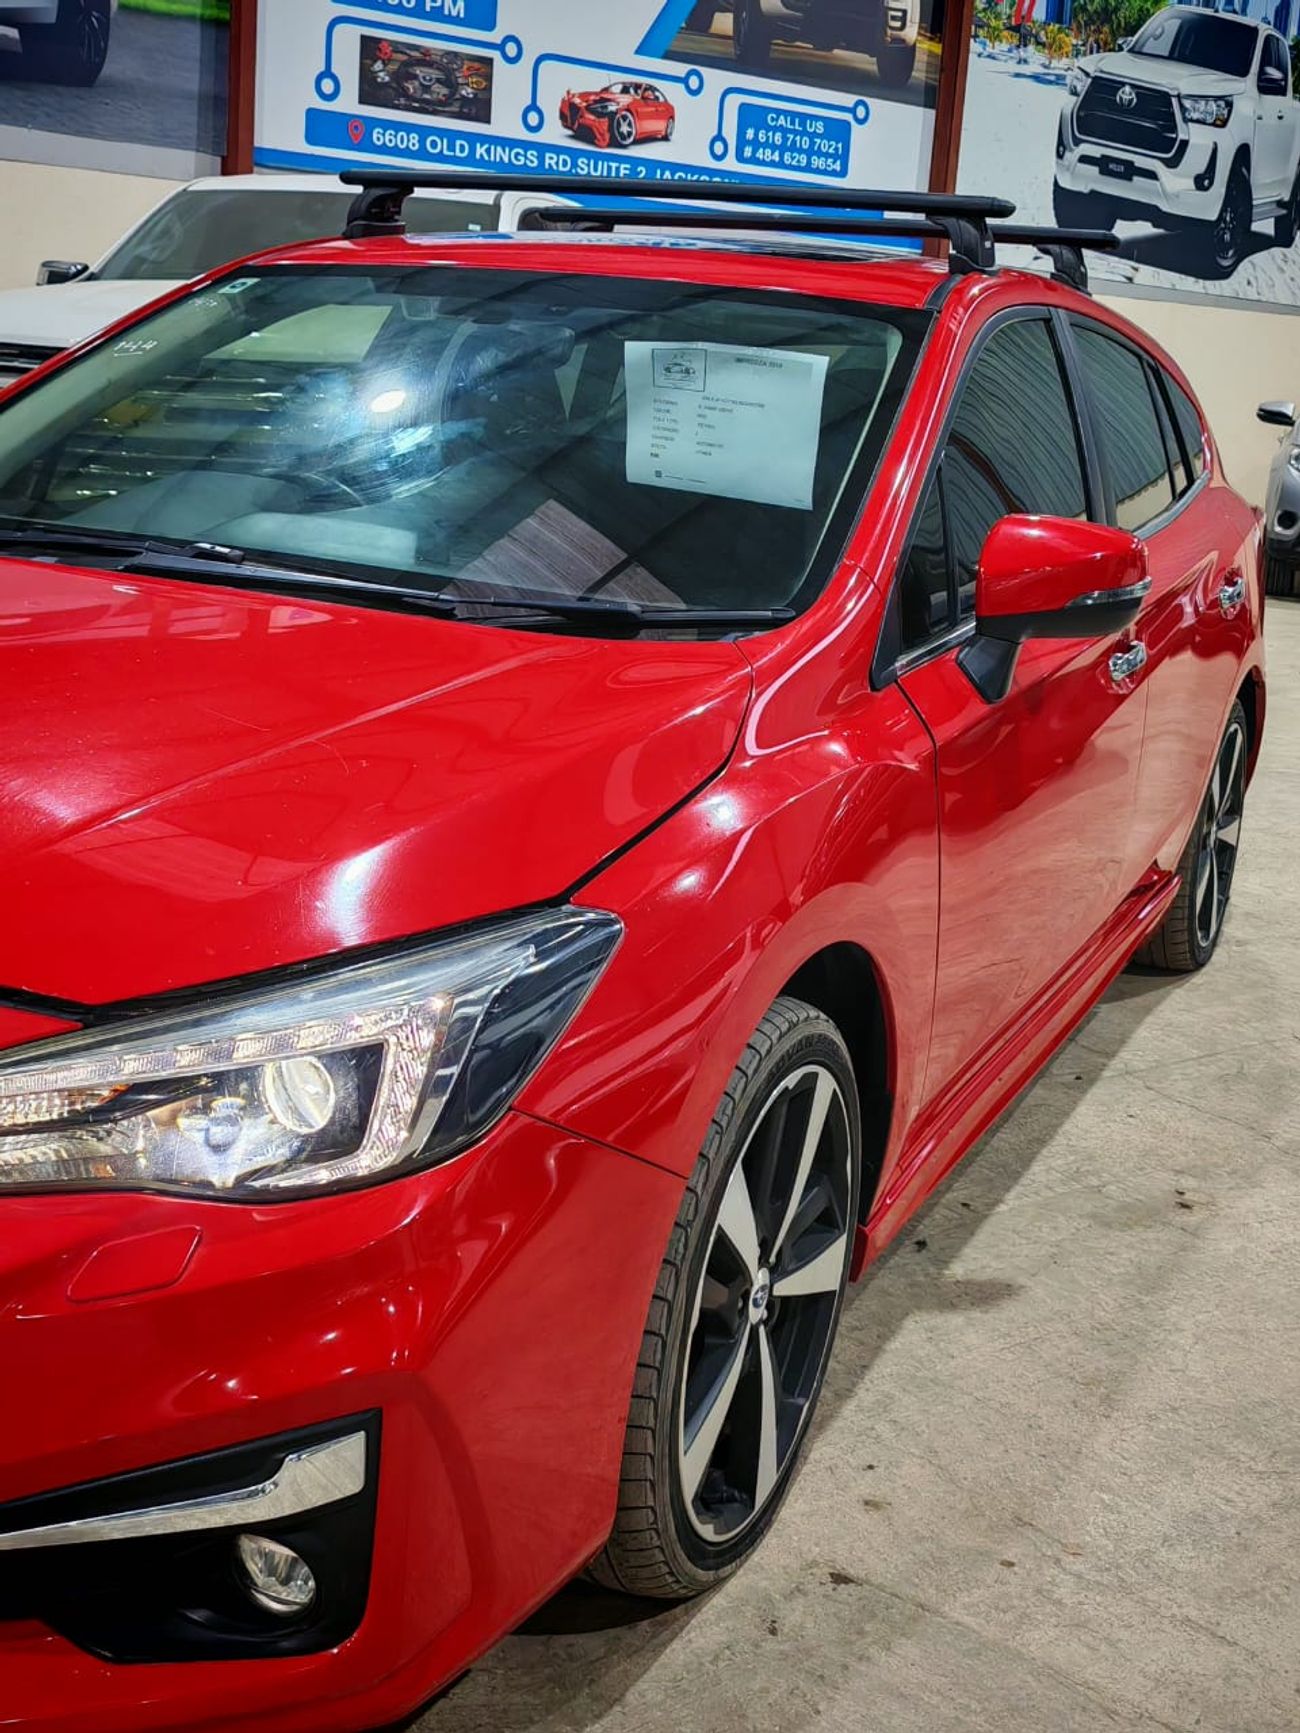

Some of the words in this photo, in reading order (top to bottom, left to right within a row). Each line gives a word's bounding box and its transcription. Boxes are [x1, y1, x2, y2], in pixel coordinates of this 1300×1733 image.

[425, 0, 465, 18] PM
[767, 113, 803, 131] CALL
[807, 119, 825, 134] US
[372, 128, 420, 151] 6608
[426, 137, 469, 158] OLD
[475, 143, 538, 168] KINGS
[636, 166, 647, 178] 2
[758, 129, 783, 145] 616
[786, 134, 810, 149] 710
[813, 138, 843, 155] 7021
[755, 147, 780, 163] 484
[783, 151, 807, 167] 629
[810, 155, 842, 172] 9654
